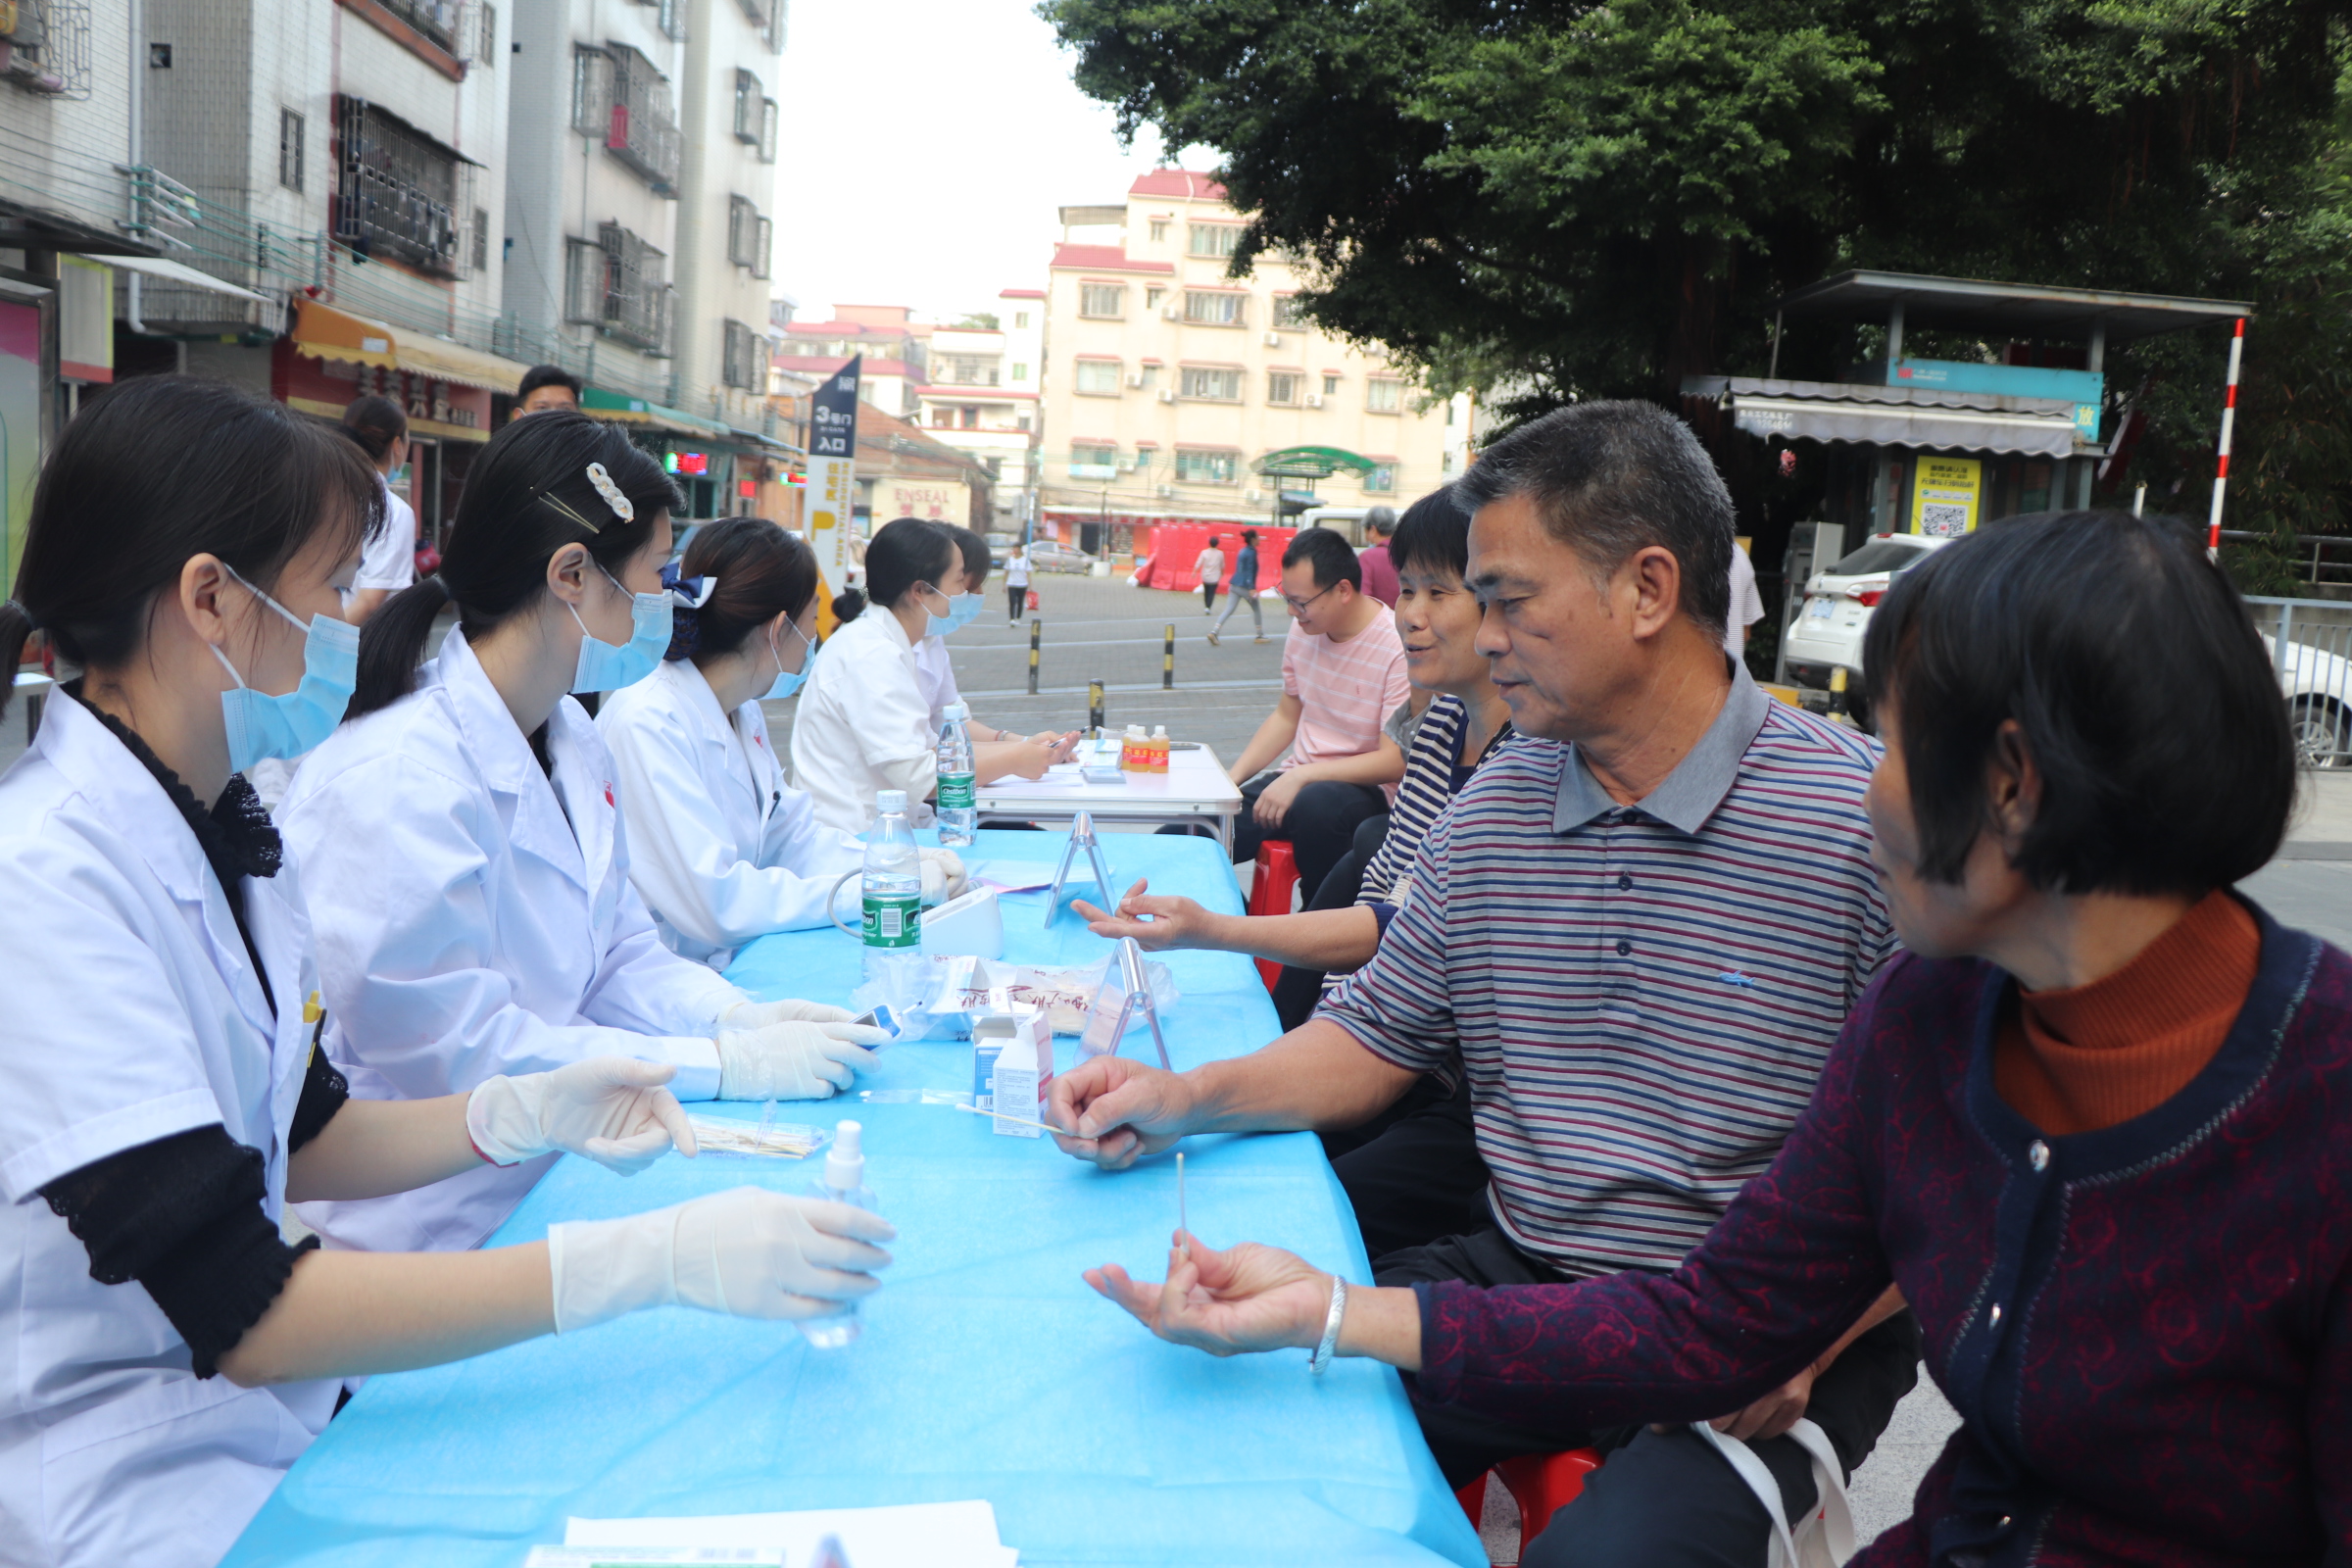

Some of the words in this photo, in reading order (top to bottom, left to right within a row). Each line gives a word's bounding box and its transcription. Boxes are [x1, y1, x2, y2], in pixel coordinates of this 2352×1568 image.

[815, 405, 853, 426] 3号门
[817, 436, 846, 453] 入口
[835, 537, 845, 567] AREA
